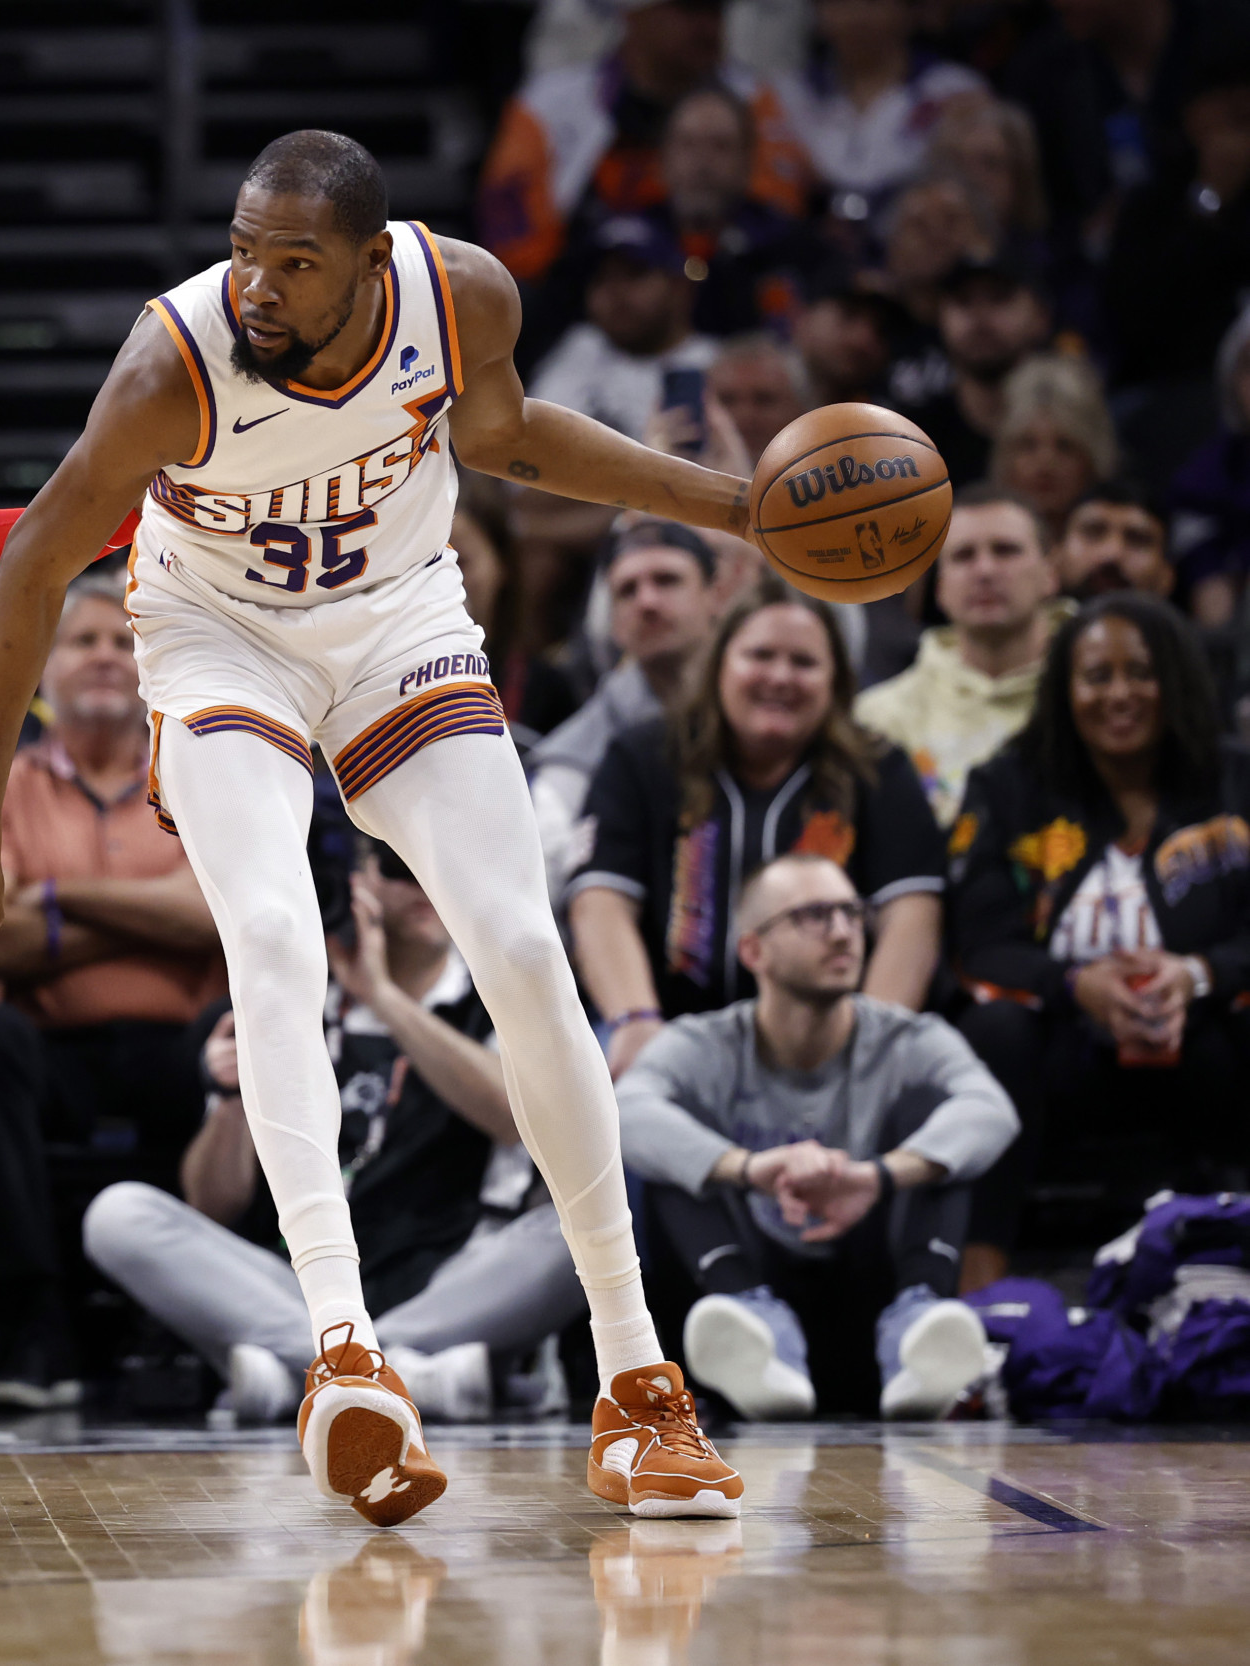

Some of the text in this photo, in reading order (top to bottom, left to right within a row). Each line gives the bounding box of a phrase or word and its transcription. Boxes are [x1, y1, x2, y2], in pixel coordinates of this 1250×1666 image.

[391, 364, 435, 395] PayPal
[784, 454, 920, 508] Wilson
[244, 509, 379, 593] 35
